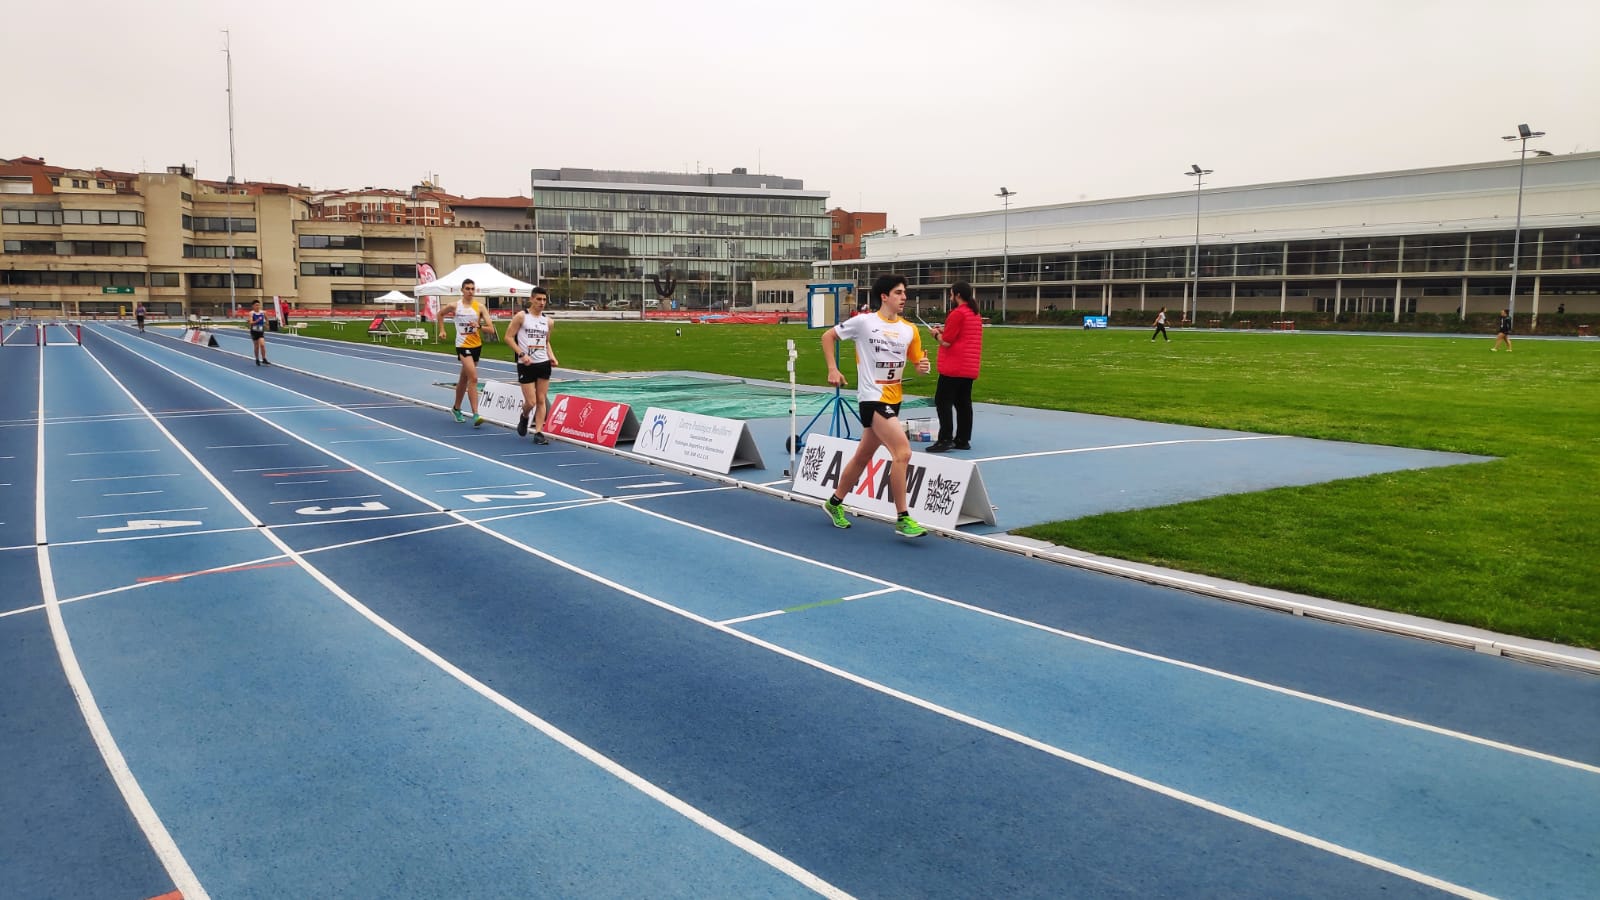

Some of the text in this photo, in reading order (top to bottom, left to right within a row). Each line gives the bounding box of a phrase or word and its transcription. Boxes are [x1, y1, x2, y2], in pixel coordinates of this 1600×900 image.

[887, 369, 895, 380] 5
[495, 394, 516, 412] IRUÑA
[822, 451, 925, 507] AXKM
[461, 490, 547, 504] 2
[295, 501, 391, 516] 3
[97, 519, 203, 534] 4
